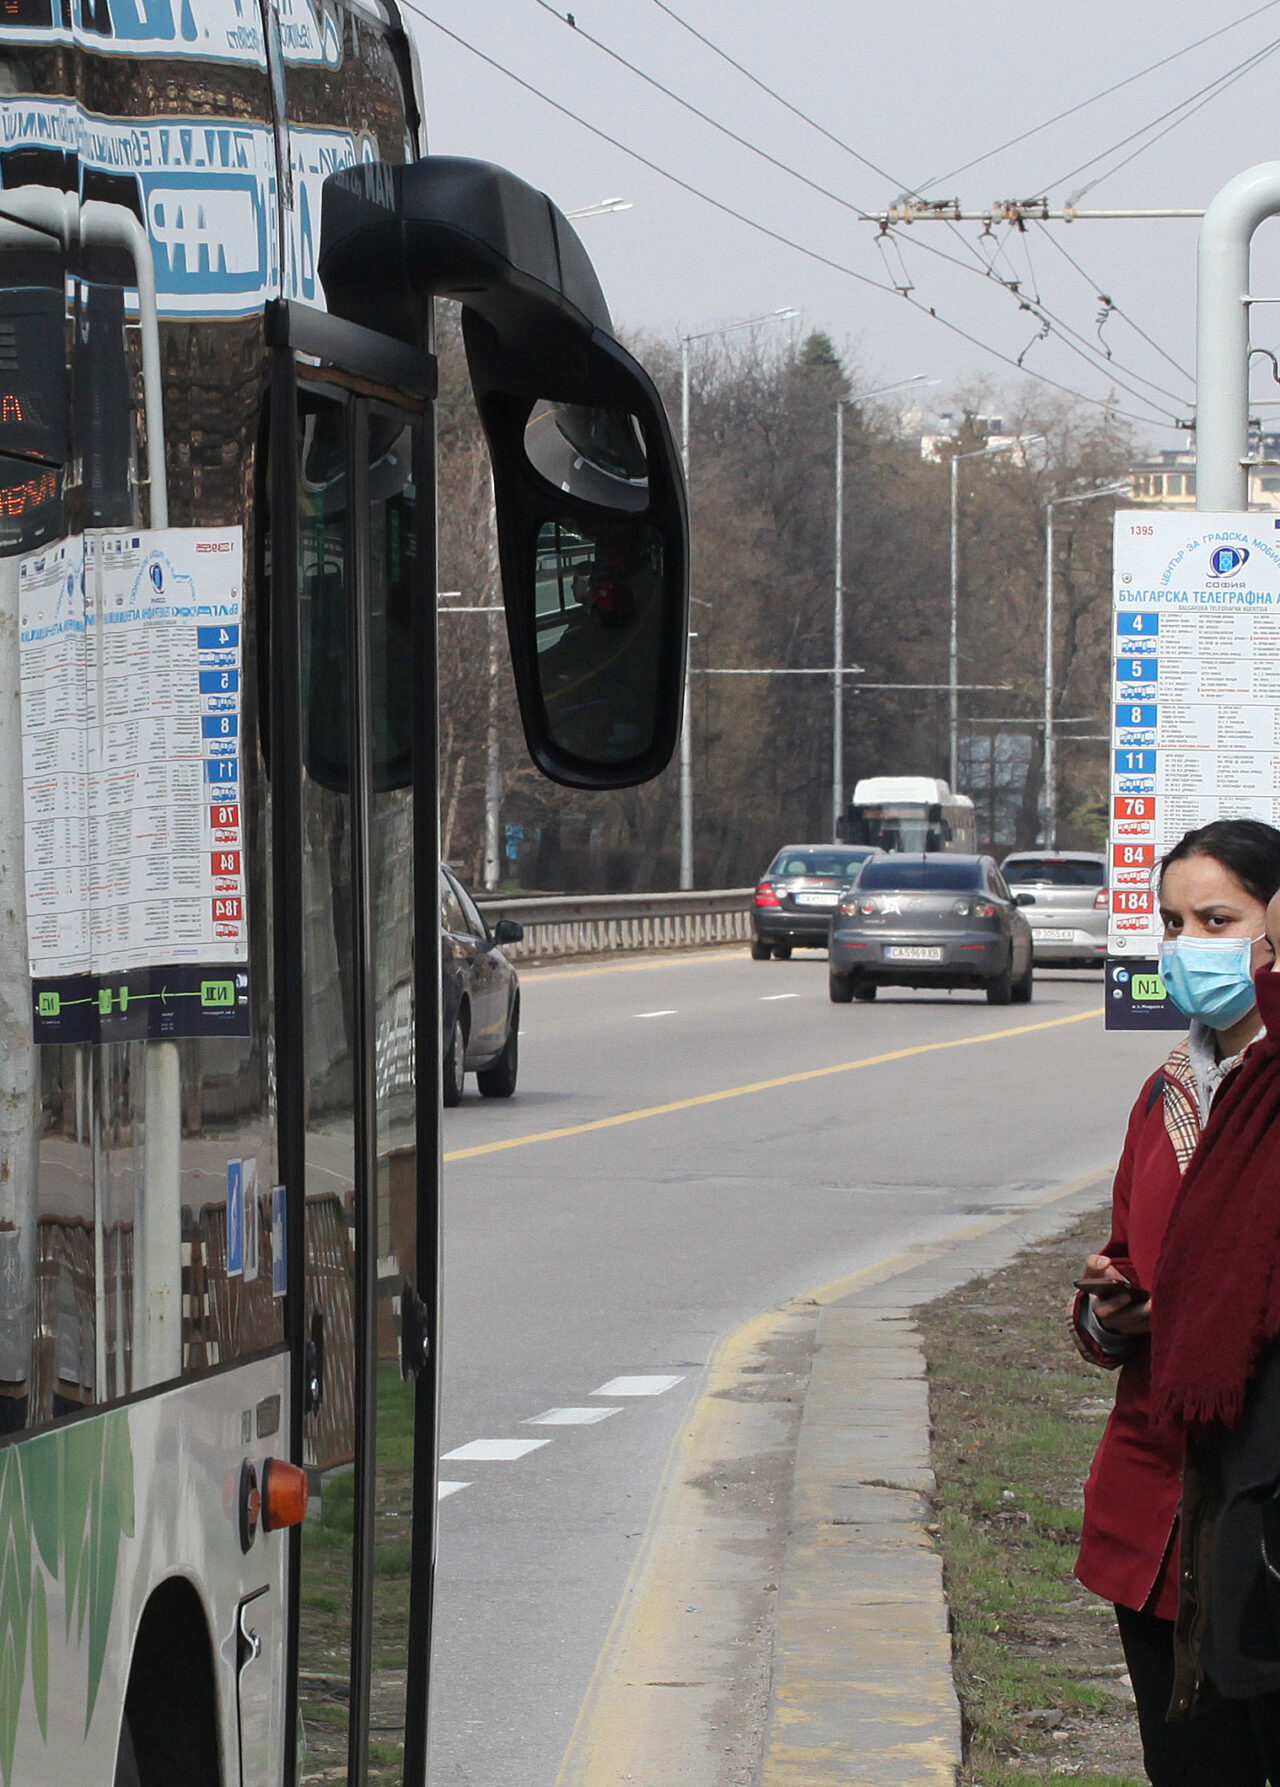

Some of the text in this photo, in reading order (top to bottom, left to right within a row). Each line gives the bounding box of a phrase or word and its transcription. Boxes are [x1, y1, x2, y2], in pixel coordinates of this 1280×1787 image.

[1129, 525, 1154, 536] 1395
[1160, 549, 1185, 586] ЦЕНТЪР
[1186, 539, 1200, 552] ЗА
[1202, 531, 1249, 545] ГРАДСКА
[1205, 581, 1246, 589] СОФИЯ
[1119, 590, 1189, 603] БЪЛГАРСКА
[1193, 590, 1272, 606] ТЕЛЕГРАФНА
[1132, 614, 1144, 632] 4
[1131, 660, 1142, 678] 5
[1131, 706, 1142, 724] 8
[1125, 752, 1145, 769] 11
[1124, 798, 1145, 816] 76
[1123, 846, 1144, 863] 84
[1118, 892, 1148, 910] 184
[1138, 979, 1160, 995] N1
